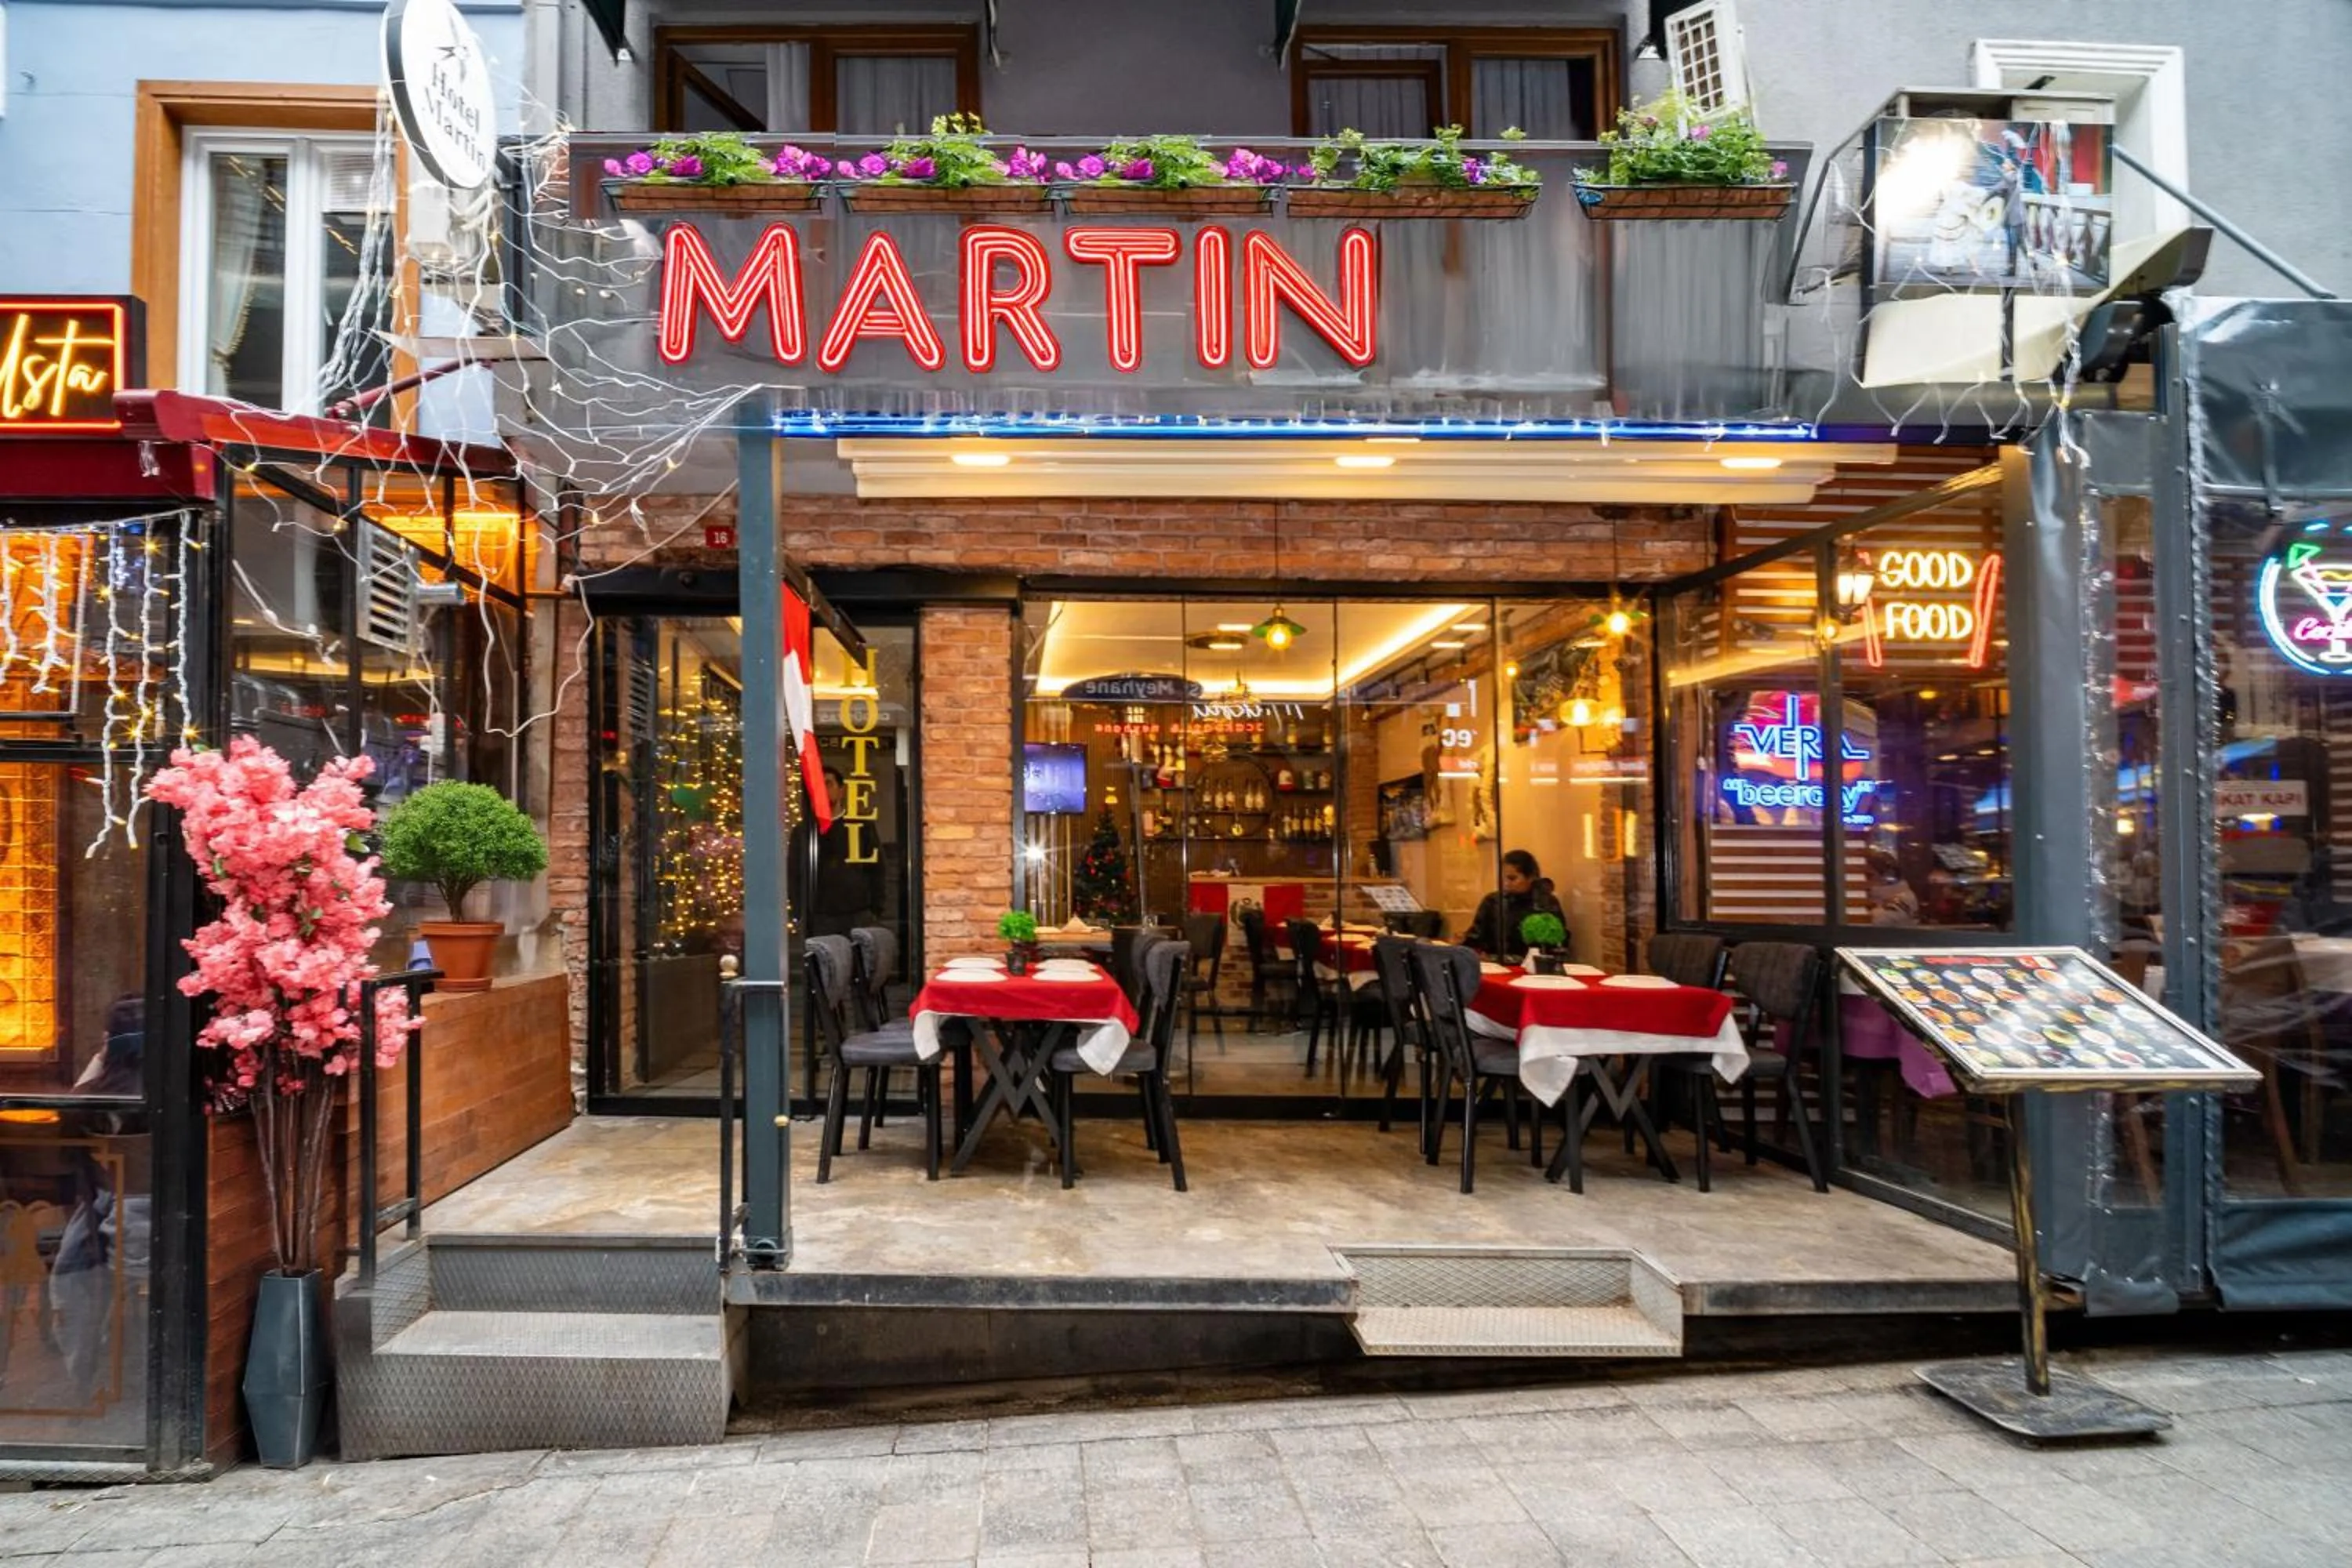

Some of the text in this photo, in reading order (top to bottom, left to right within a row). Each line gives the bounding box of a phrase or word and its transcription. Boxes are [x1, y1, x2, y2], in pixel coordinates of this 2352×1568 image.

[425, 86, 486, 172] Martin
[432, 62, 480, 133] Hotel
[658, 221, 1377, 373] MARTIN
[714, 531, 728, 544] 16
[1879, 551, 1973, 588] GOOD
[1885, 601, 1973, 640] FOOD
[840, 648, 879, 863] HOTEL
